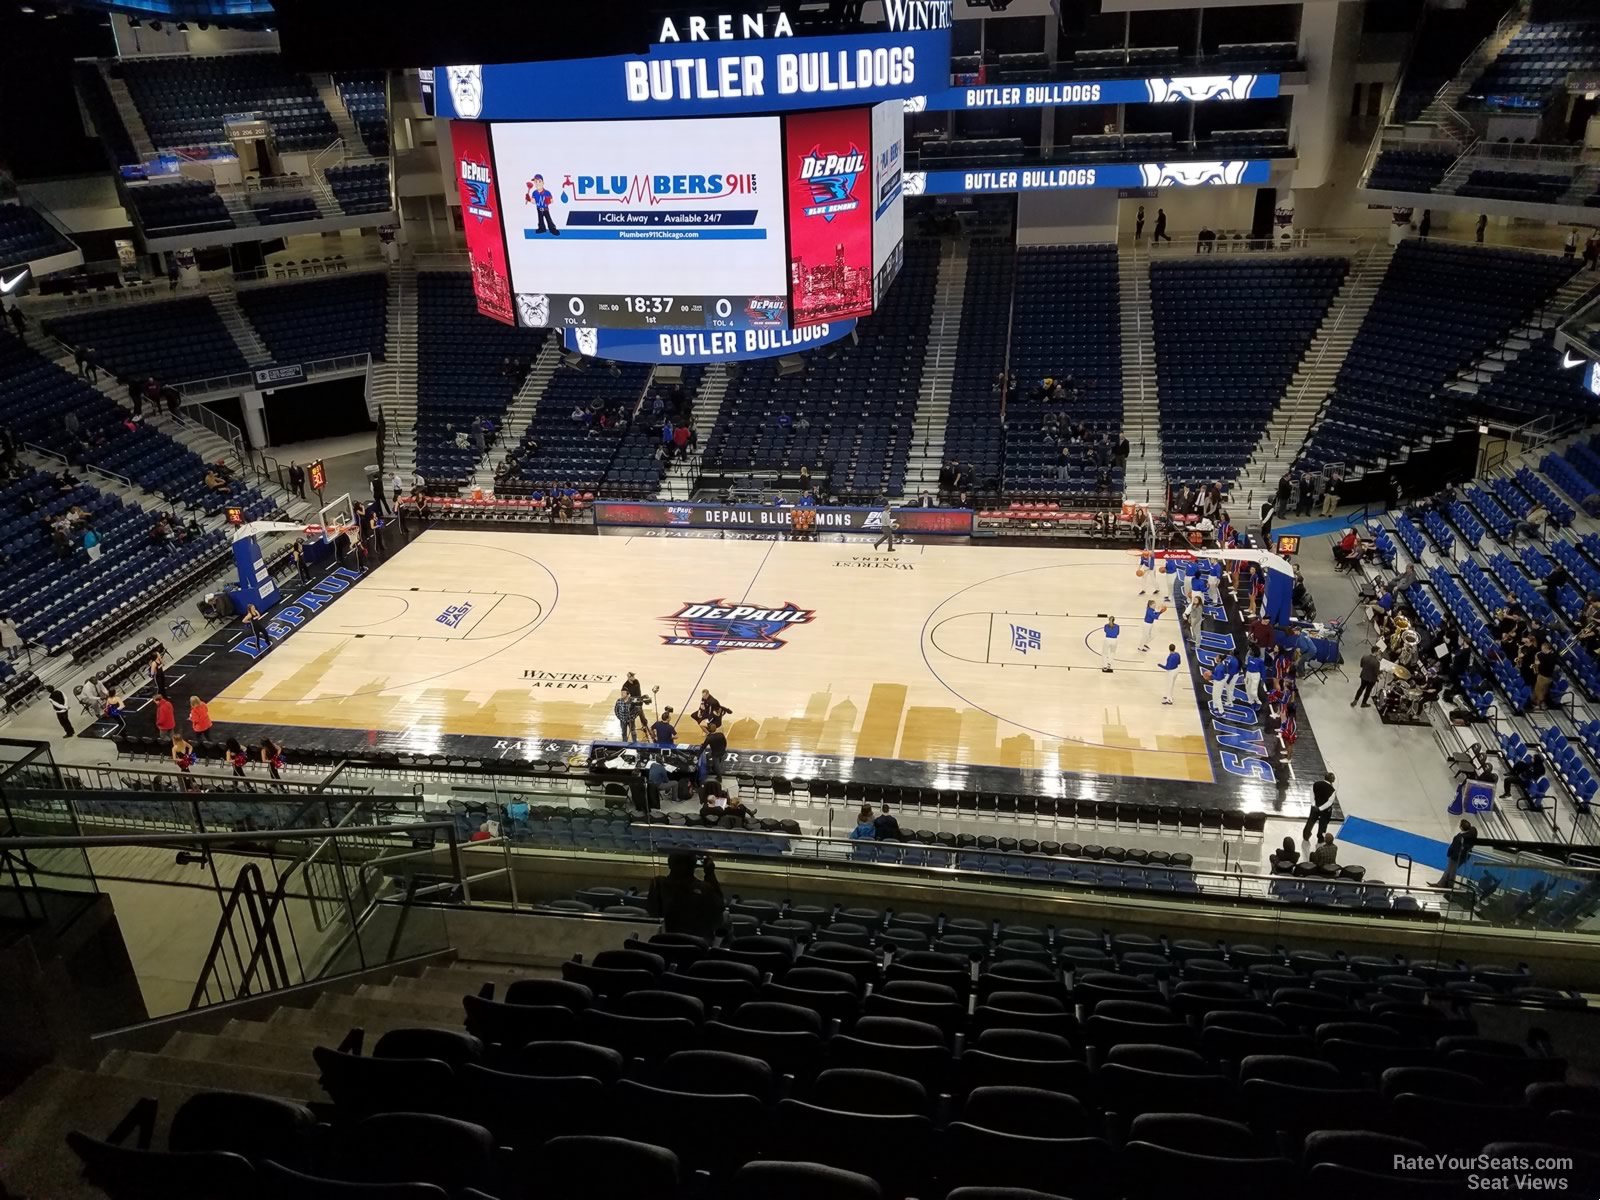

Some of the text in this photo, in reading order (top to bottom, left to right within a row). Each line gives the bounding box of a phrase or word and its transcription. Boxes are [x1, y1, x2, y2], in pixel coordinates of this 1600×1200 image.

[659, 12, 793, 42] ARENA
[625, 46, 915, 101] BUTLER BULLDOGS
[966, 84, 1100, 107] BUTLER BULLDOGS
[461, 160, 491, 183] DEPAUL
[801, 154, 865, 179] DEPAUL
[964, 169, 1096, 190] BUTLER BULLDOGS
[807, 201, 857, 215] BLUE DEMONS
[626, 214, 648, 225] Away
[664, 213, 702, 223] Available
[704, 213, 722, 223] 24/7
[619, 230, 699, 239] Plumbers911Chicago.com
[568, 296, 585, 316] 0
[624, 297, 674, 312] 18:37
[715, 298, 732, 318] 0
[750, 299, 785, 309] DEPAUL
[645, 315, 657, 324] 1st
[659, 323, 829, 356] BUTLER BULLDOGS
[705, 510, 851, 526] DEPAUL BLUE MONS
[833, 533, 915, 544] CHICGO
[832, 561, 914, 570] WINTRUST
[228, 566, 369, 659] DEPAUL
[435, 605, 458, 623] BIG
[444, 601, 472, 627] EAST
[678, 604, 806, 623] DEPAUL
[674, 638, 777, 649] BLUE DEMONS
[1014, 626, 1027, 655] EAST
[1028, 629, 1041, 650] BIG
[523, 670, 617, 682] WINTRUST
[532, 682, 589, 690] ARENA
[1196, 631, 1276, 783] DEONS
[545, 742, 560, 751] &
[749, 754, 832, 768] CORT
